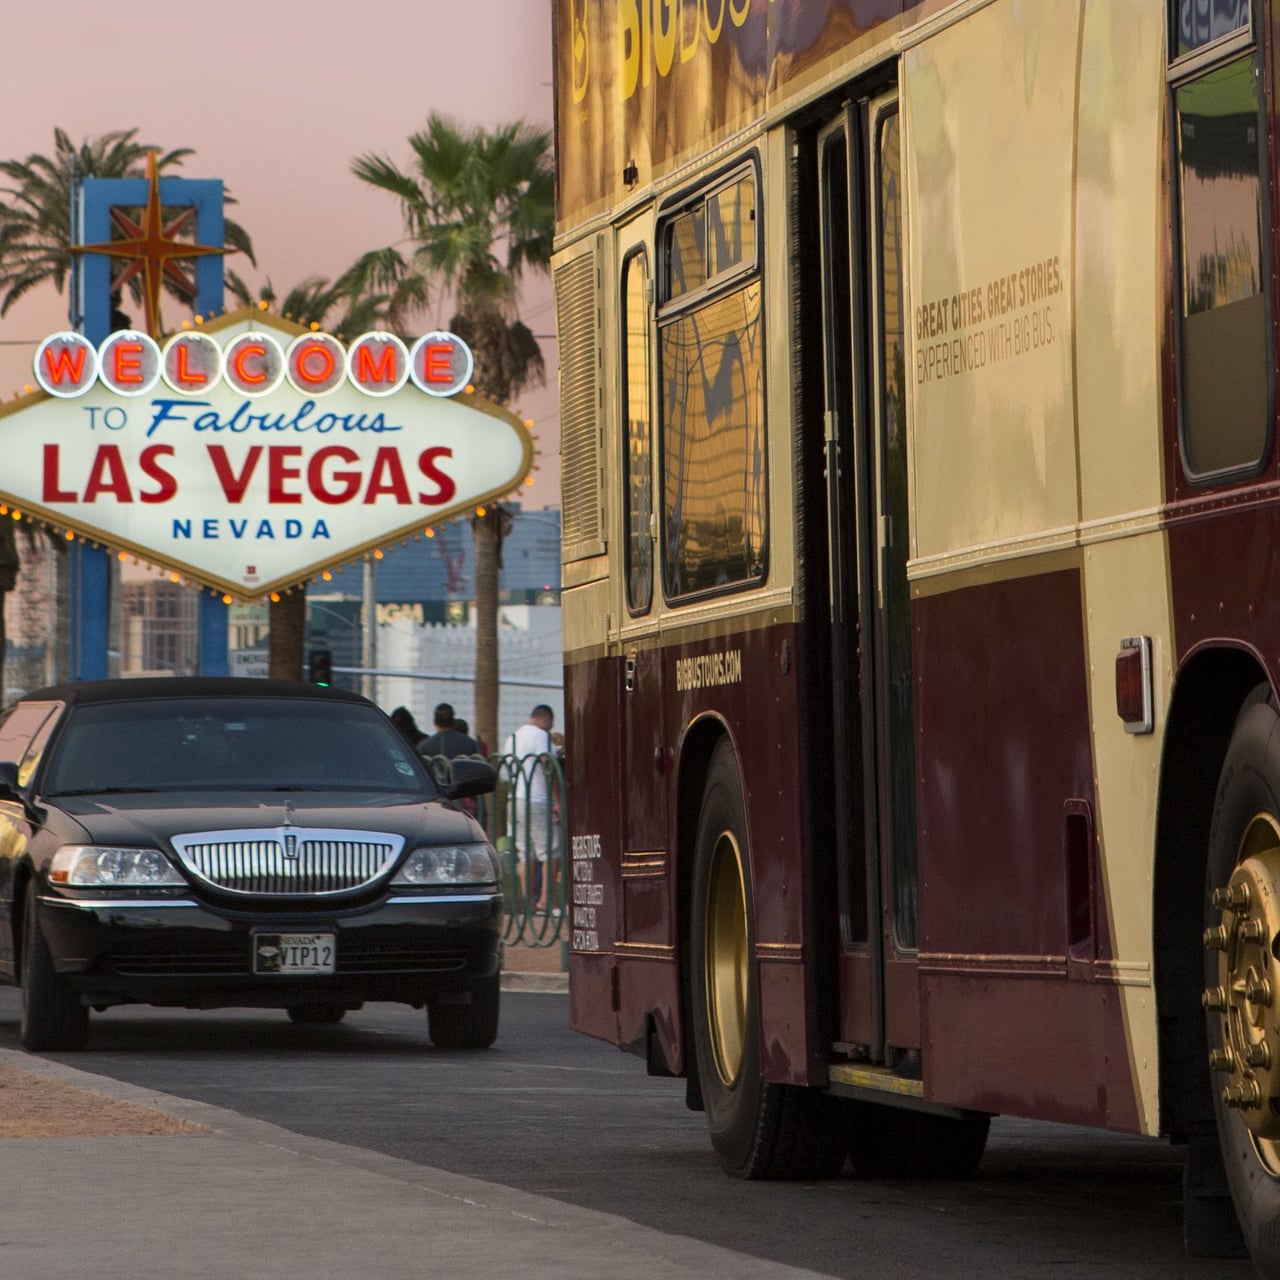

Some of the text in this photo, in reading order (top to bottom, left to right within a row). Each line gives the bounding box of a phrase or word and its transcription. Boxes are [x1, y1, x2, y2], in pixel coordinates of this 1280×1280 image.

[916, 256, 1063, 341] GREAT CITIES. GREAT STORIES.
[44, 341, 456, 386] WELCOME
[917, 306, 1055, 385] EXPERIENCED WITH BIG BUS.
[83, 400, 403, 438] TO Fabulous
[43, 444, 457, 506] LAS VEGAS
[172, 519, 332, 540] NEVADA
[676, 648, 742, 691] BIGBUSTOURS.COM
[280, 946, 332, 966] VIP12
